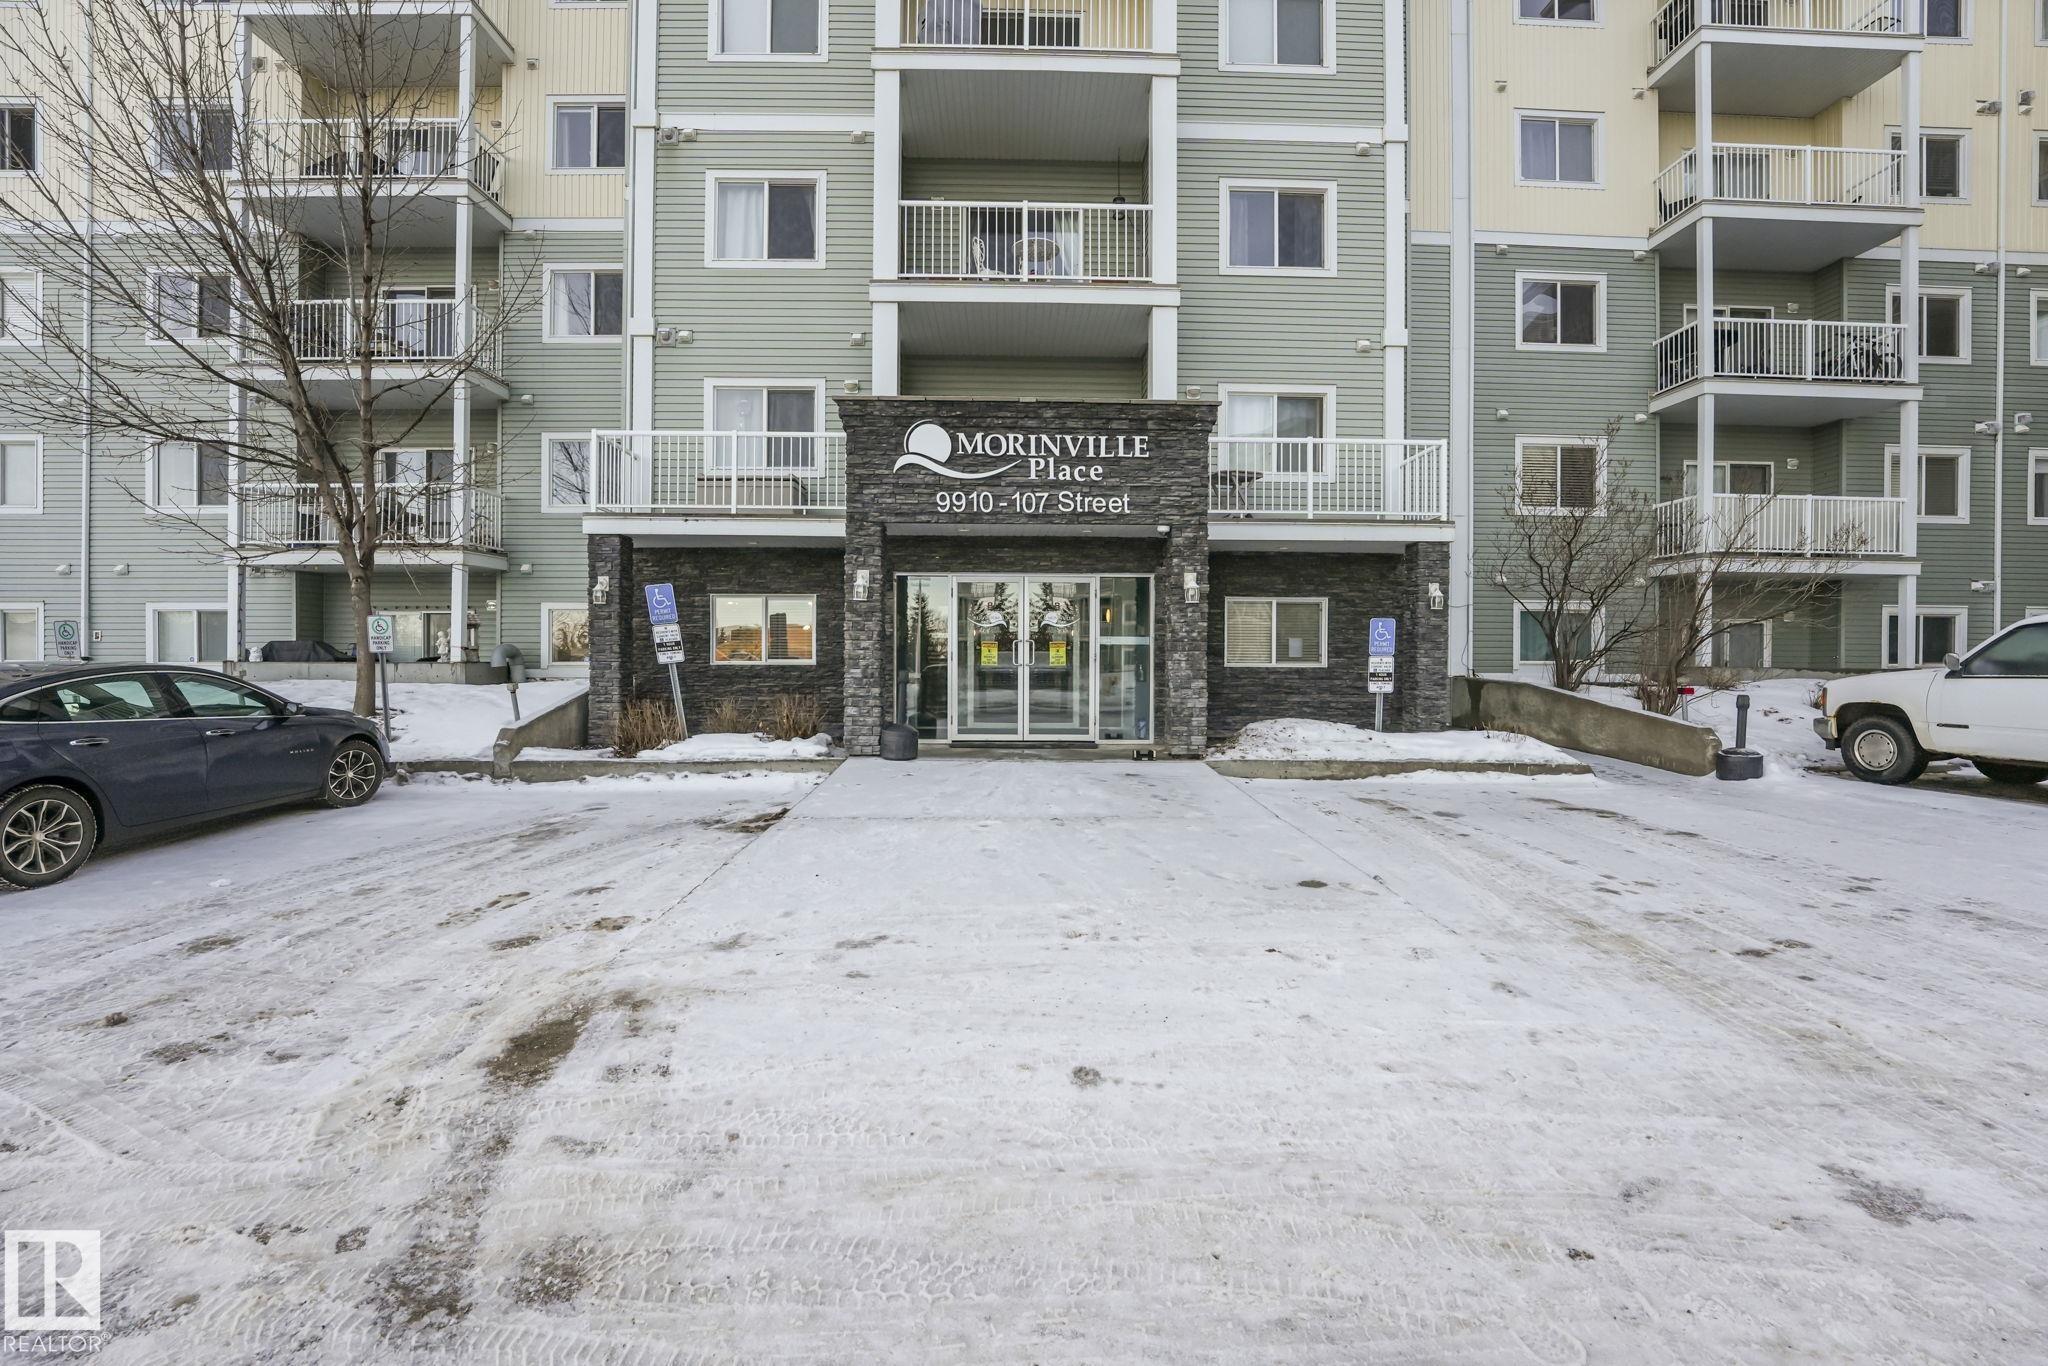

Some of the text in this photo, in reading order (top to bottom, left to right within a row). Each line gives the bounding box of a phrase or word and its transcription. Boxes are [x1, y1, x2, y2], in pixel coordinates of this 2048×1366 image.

[956, 432, 1149, 458] MORINVILLE
[1028, 457, 1103, 481] Place
[1058, 490, 1130, 513] Street
